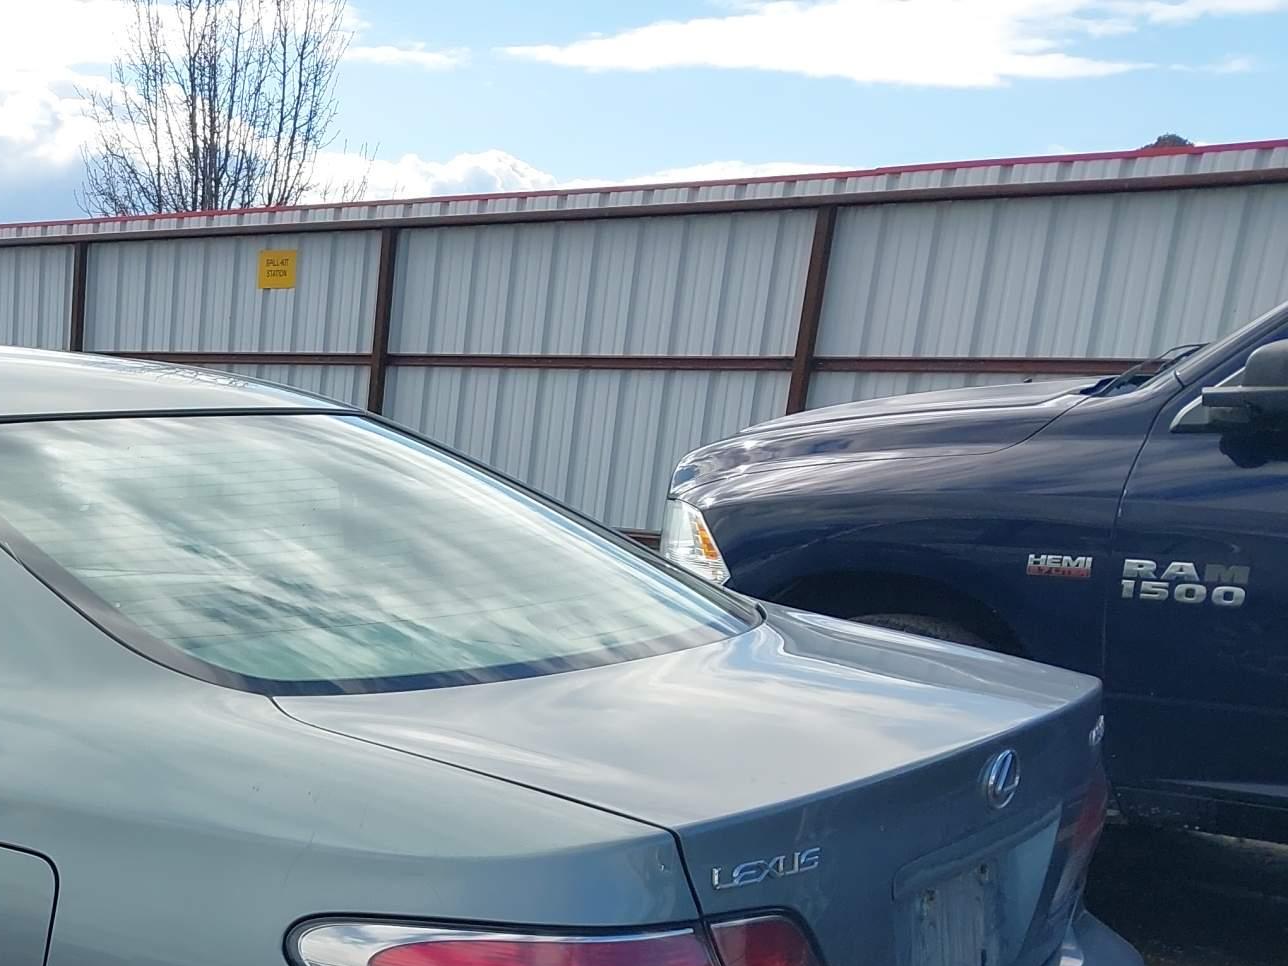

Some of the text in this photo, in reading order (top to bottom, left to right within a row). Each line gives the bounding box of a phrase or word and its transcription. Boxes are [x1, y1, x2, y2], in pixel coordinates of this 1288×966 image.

[266, 269, 288, 278] STATION
[1028, 554, 1093, 569] HEMI
[1123, 558, 1251, 585] RAM
[1120, 579, 1247, 607] 1500
[711, 847, 821, 890] LEXUS
